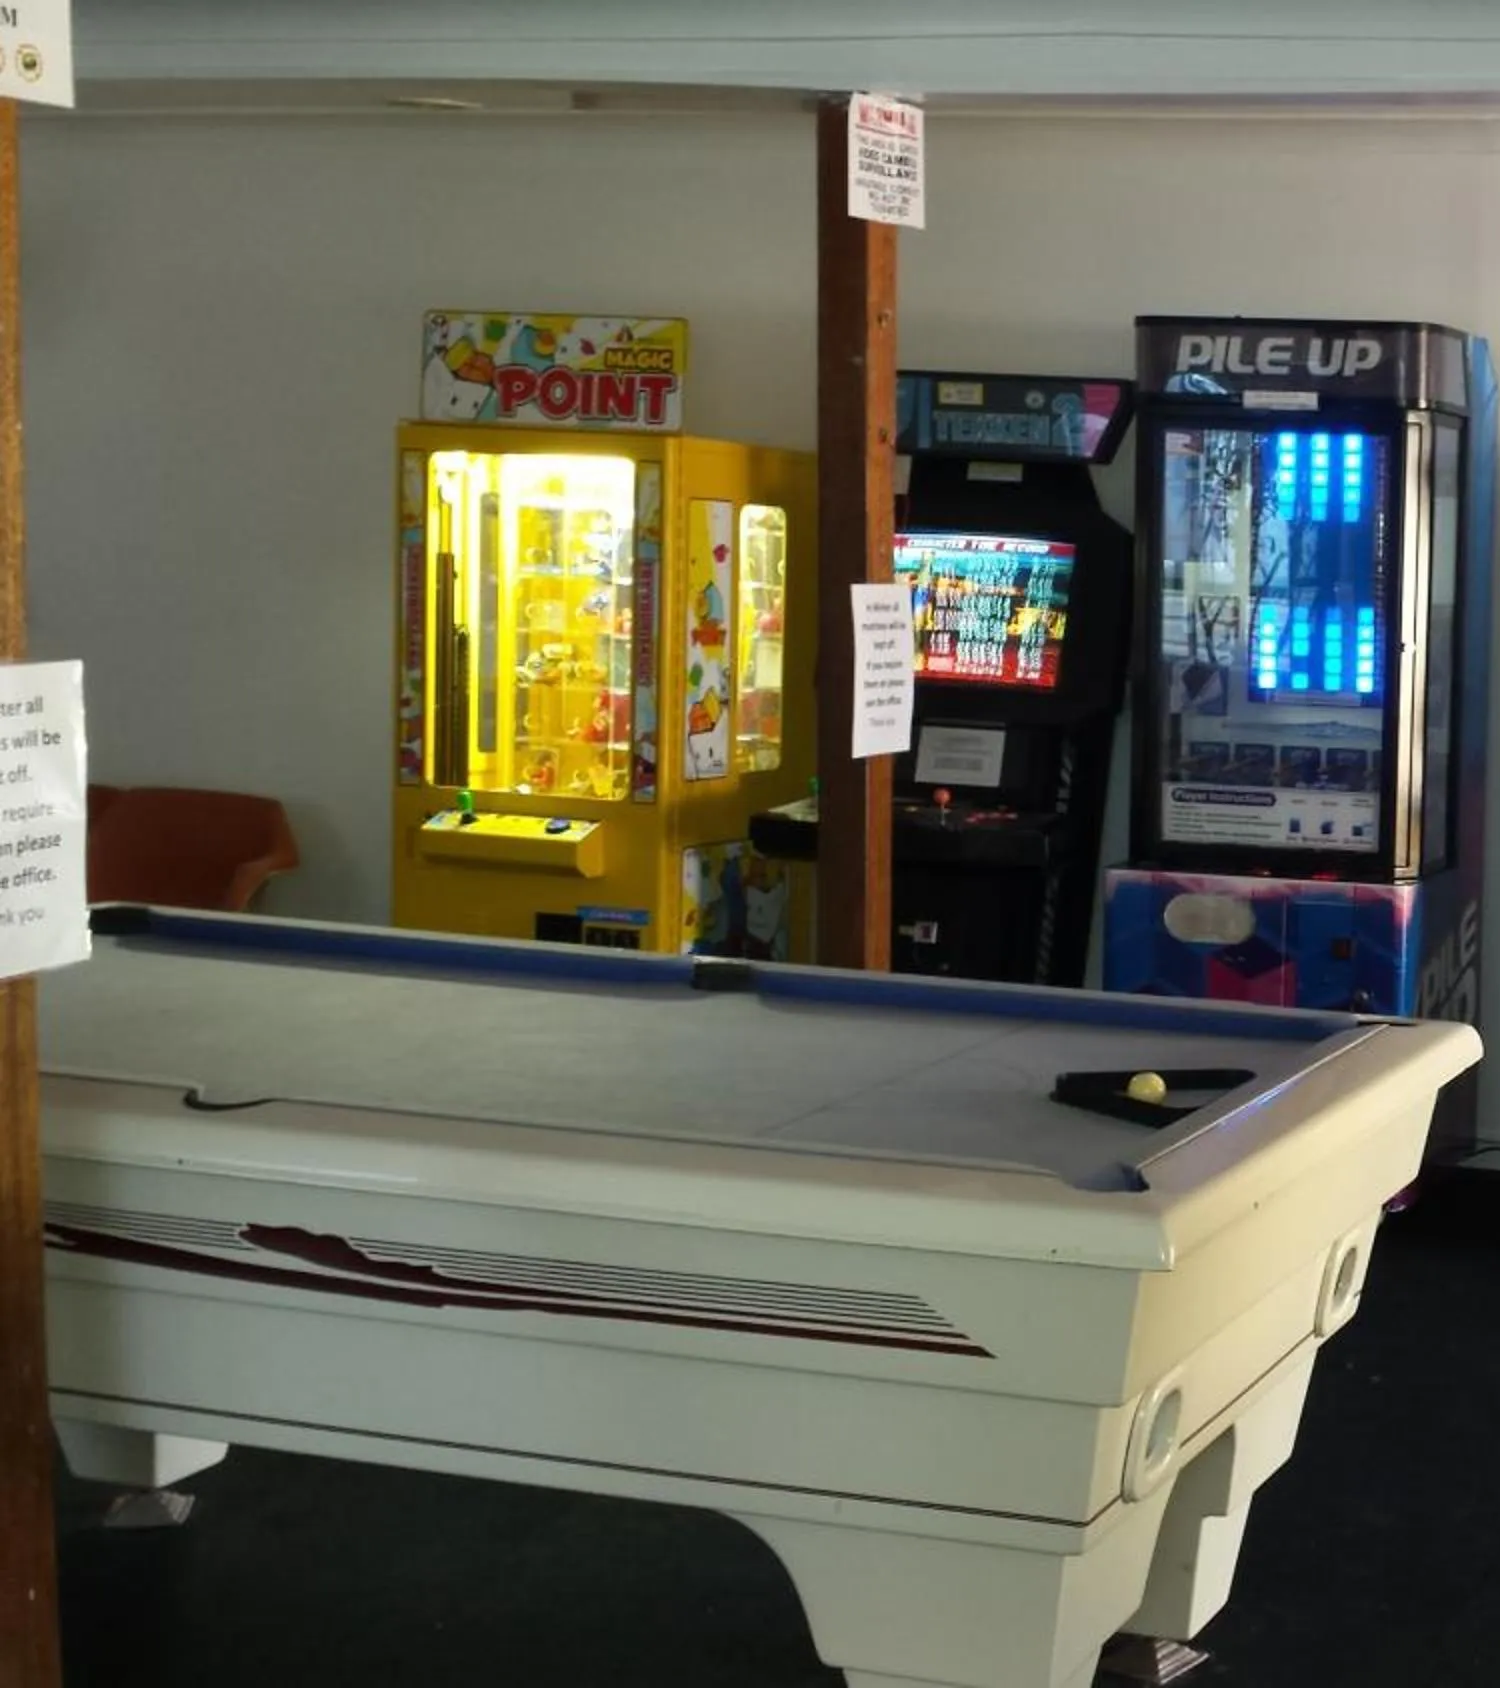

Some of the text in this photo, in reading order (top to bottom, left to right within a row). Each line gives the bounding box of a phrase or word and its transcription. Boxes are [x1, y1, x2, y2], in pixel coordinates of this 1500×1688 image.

[606, 350, 673, 369] MAGIC
[1175, 334, 1383, 377] PILE UP
[496, 367, 675, 424] POINT
[0, 695, 43, 717] ter all
[12, 729, 38, 749] will
[41, 729, 61, 746] be
[17, 834, 62, 858] please
[13, 866, 57, 889] office.
